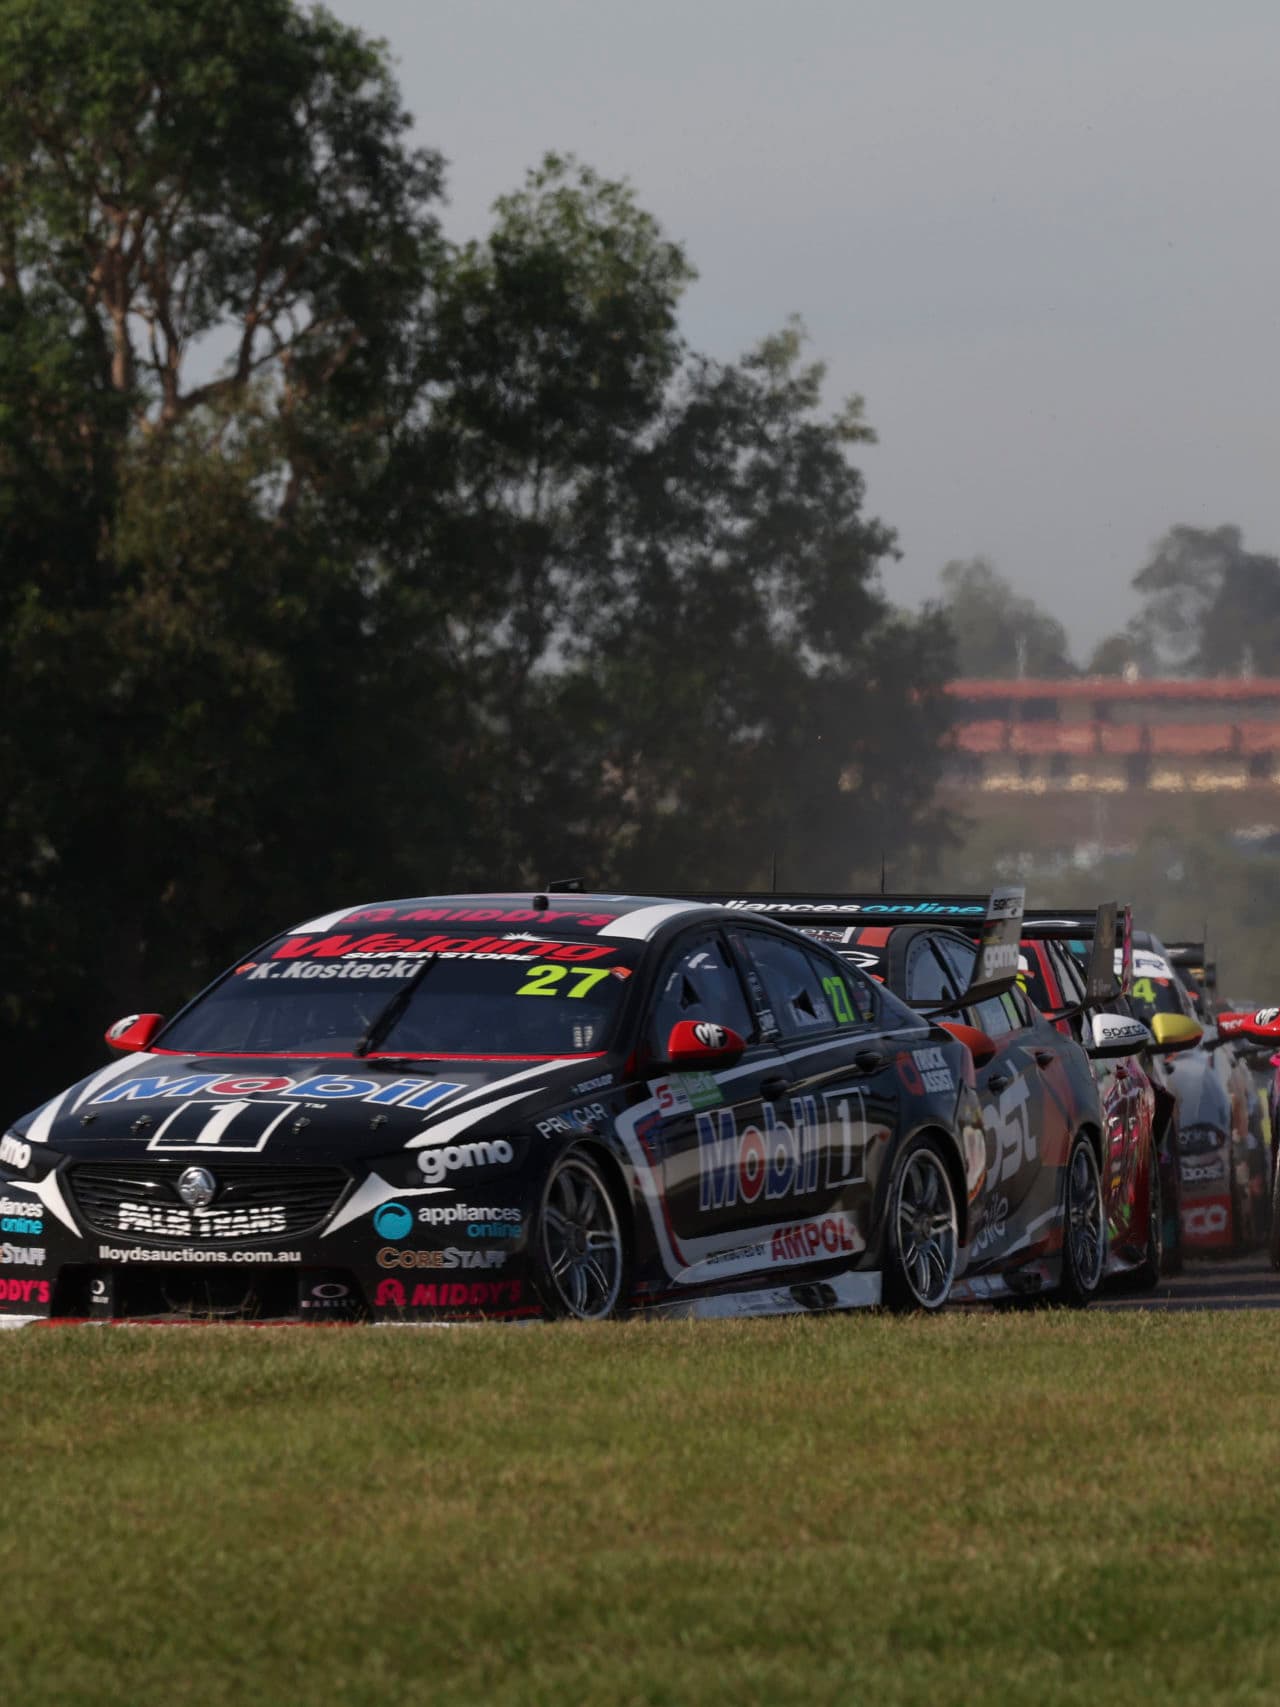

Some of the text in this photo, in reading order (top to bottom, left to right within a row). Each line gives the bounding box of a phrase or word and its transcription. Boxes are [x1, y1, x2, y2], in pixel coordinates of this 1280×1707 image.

[402, 908, 619, 927] MIDDY'S
[861, 903, 984, 914] online
[272, 933, 618, 961] Welding
[247, 960, 426, 980] K.Kostecki
[516, 964, 610, 998] 27
[88, 1074, 469, 1110] Mobil
[417, 1140, 513, 1184] gomo
[695, 1094, 819, 1212] Mobil
[0, 1197, 44, 1218] iances
[418, 1204, 522, 1226] appliances
[0, 1218, 44, 1235] online
[467, 1223, 523, 1238] online
[771, 1218, 854, 1261] AMPOL
[0, 1243, 47, 1266] STAFF
[99, 1245, 301, 1263] lloydsauctions.com.au
[411, 1279, 522, 1307] MIDDY'S
